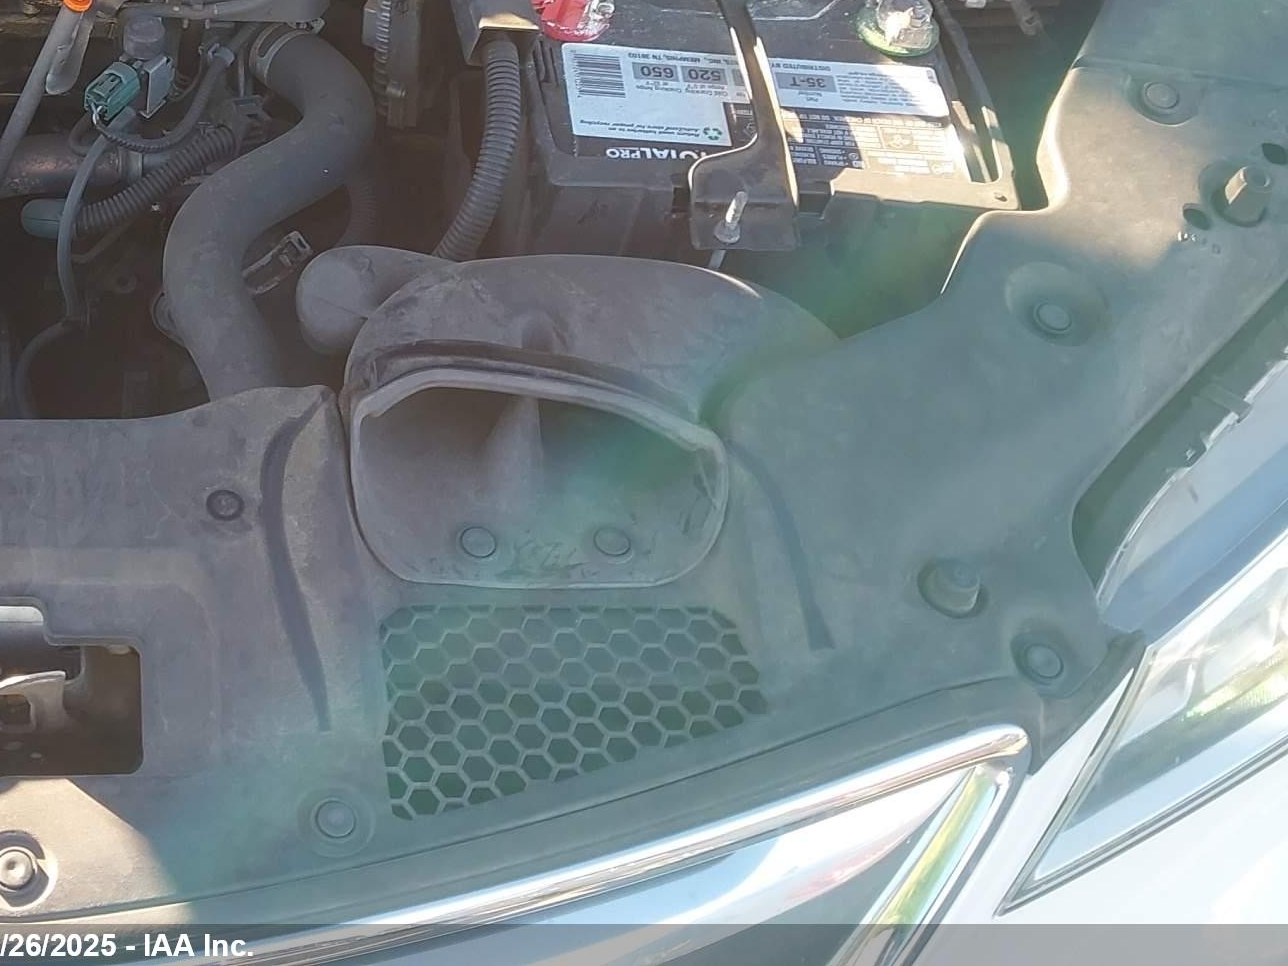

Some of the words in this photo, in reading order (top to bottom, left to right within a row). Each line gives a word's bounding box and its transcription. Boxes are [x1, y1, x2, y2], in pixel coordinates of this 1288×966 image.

[640, 65, 674, 79] 650
[687, 68, 721, 81] 520
[790, 76, 826, 88] 35-T
